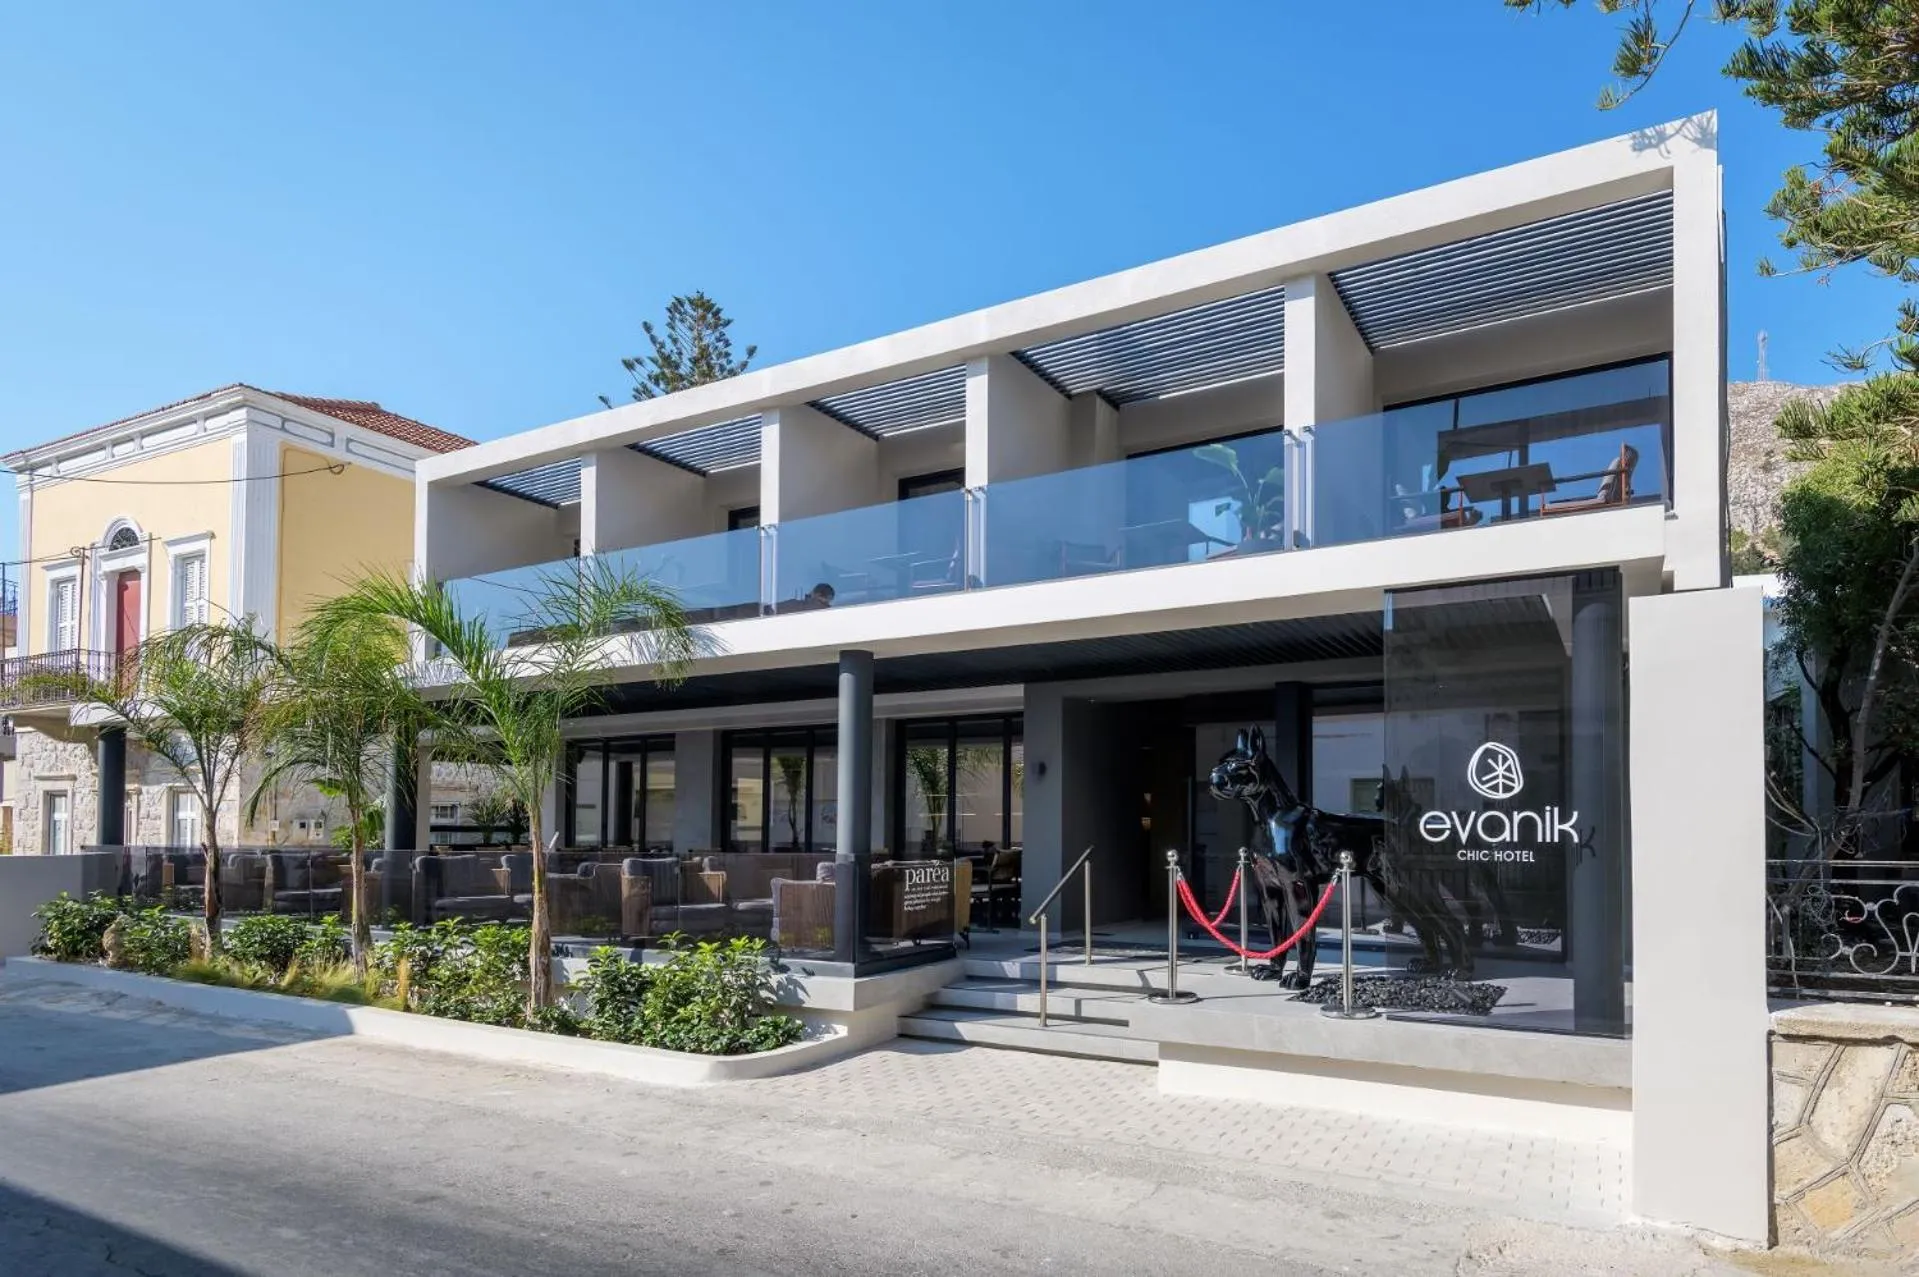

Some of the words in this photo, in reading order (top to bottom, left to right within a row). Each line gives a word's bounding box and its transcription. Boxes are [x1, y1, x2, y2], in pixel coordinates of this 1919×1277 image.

[1419, 806, 1579, 844] evanik
[1457, 850, 1489, 861] CHIC
[1494, 850, 1535, 862] HOTEL
